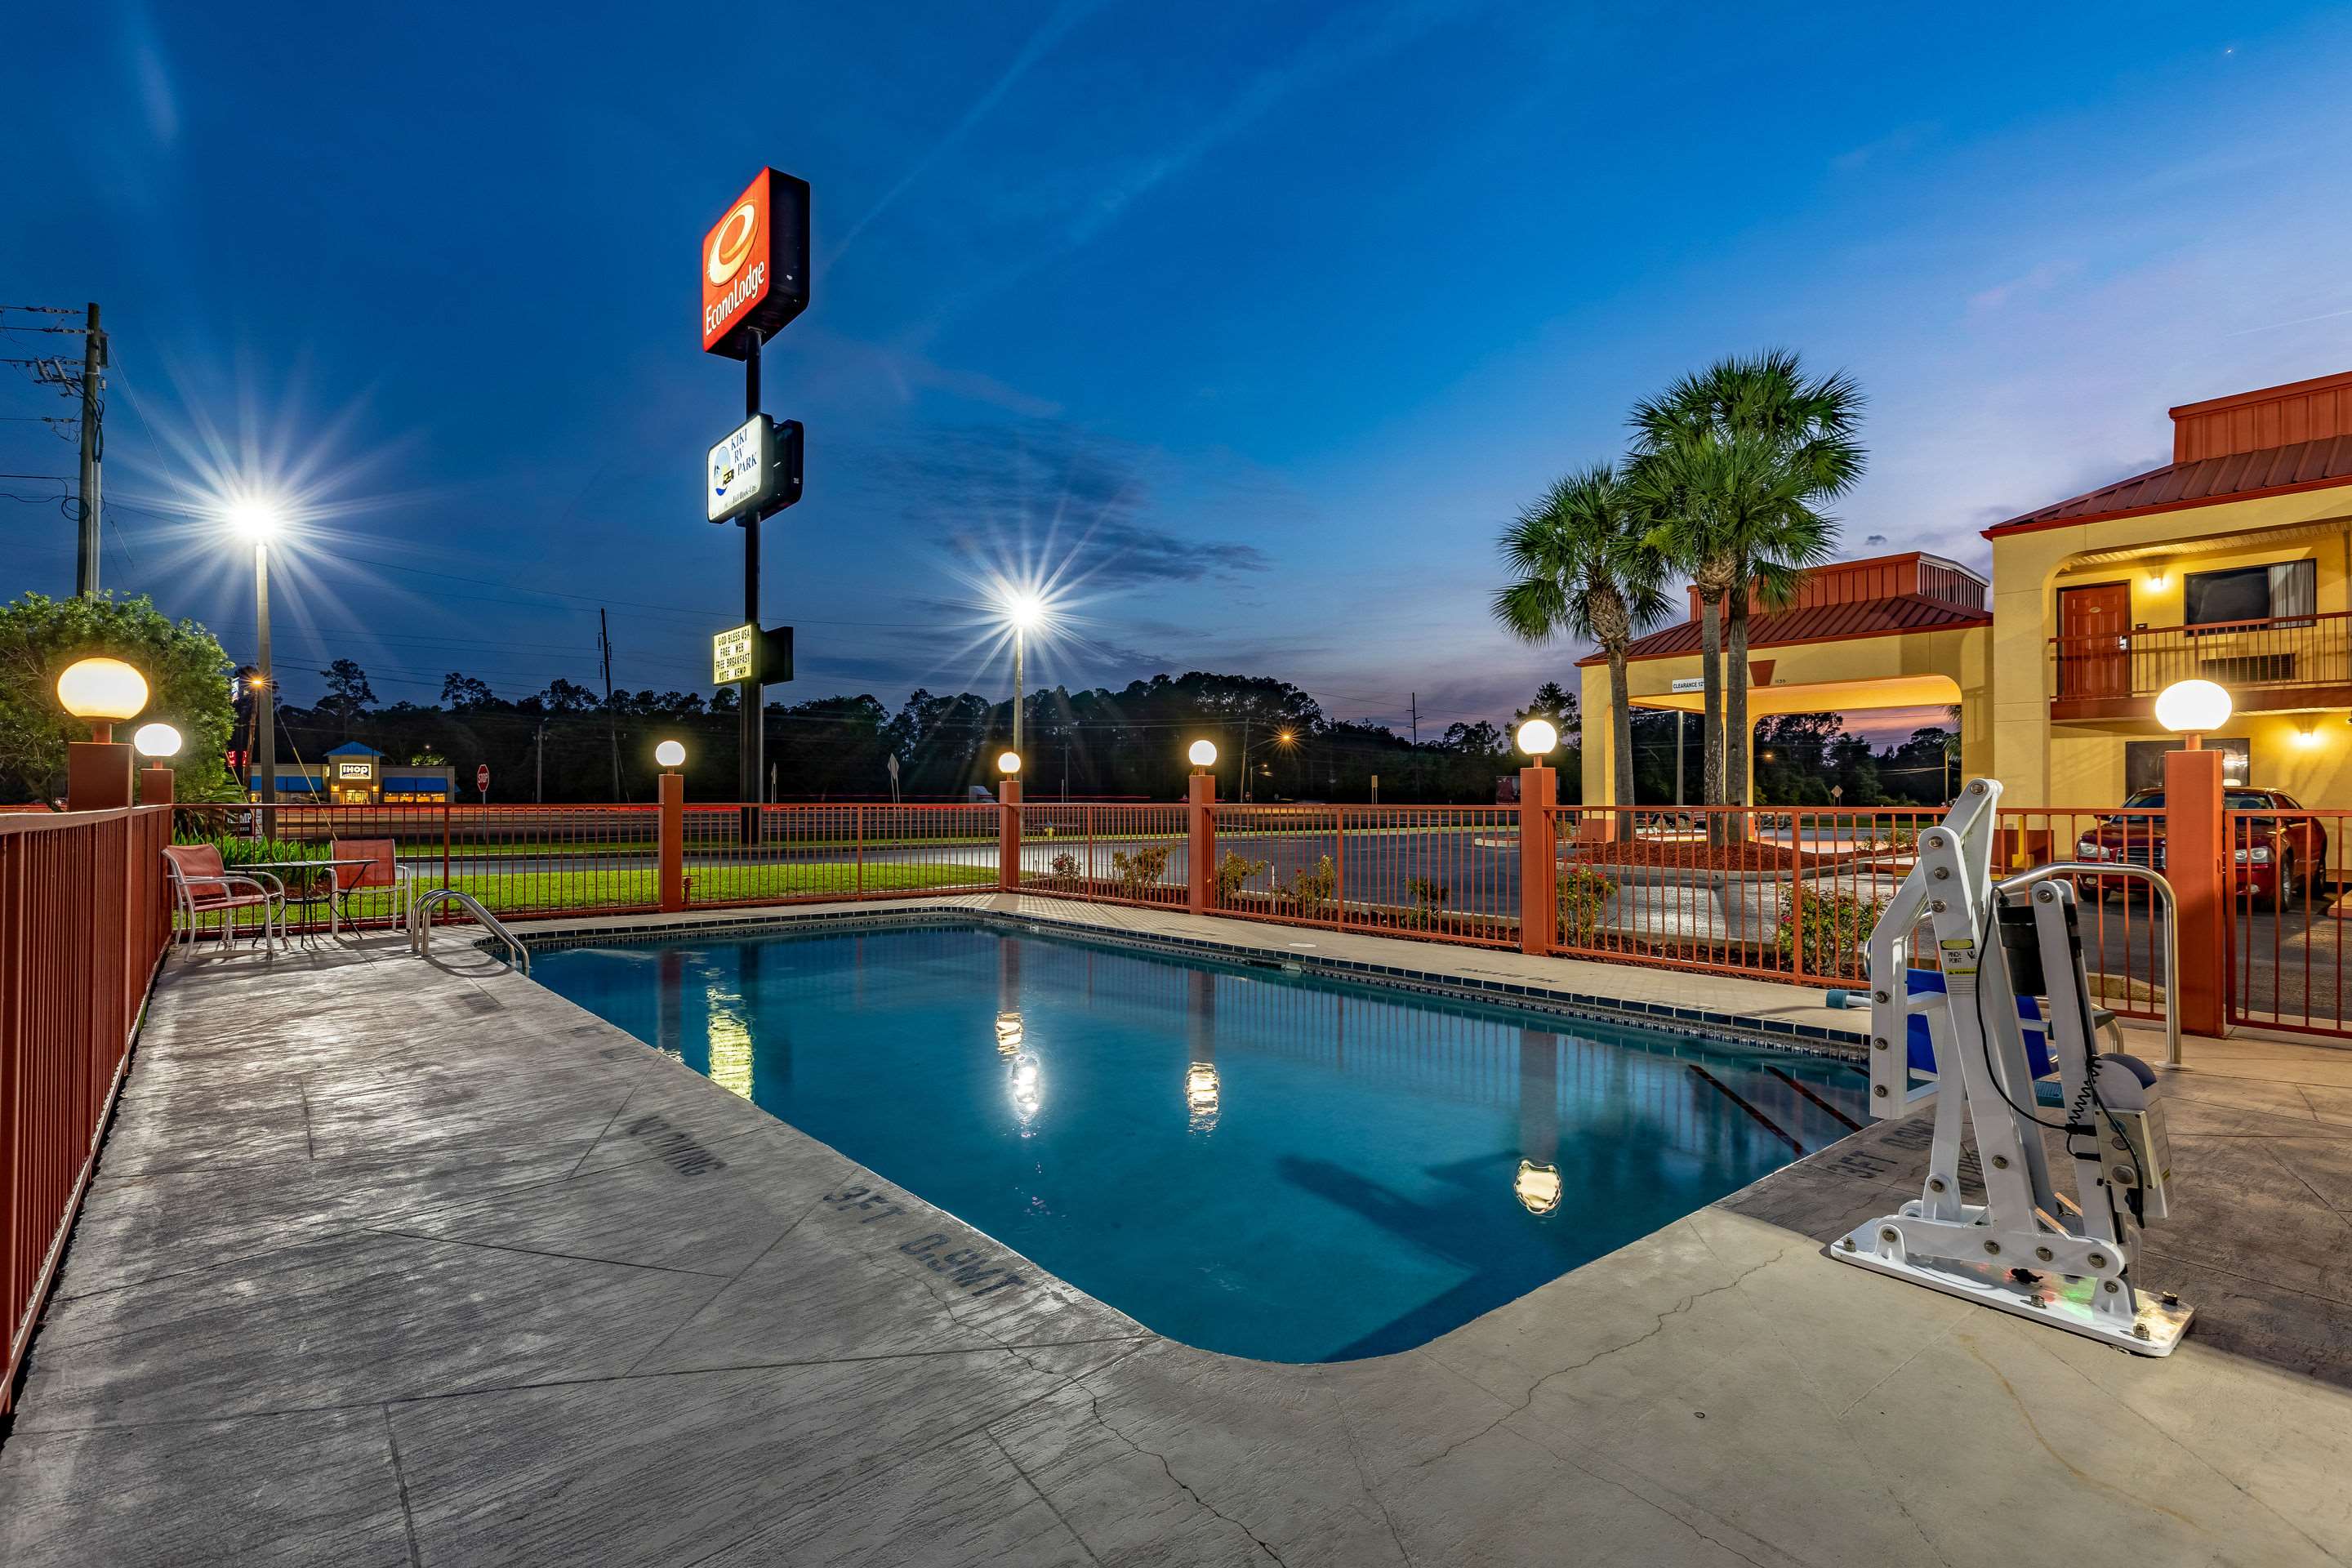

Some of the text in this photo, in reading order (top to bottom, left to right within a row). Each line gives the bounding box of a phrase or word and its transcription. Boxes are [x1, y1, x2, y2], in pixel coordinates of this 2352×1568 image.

[706, 261, 765, 336] EconoLodge
[731, 428, 747, 451] KIKI
[735, 445, 744, 463] RV
[737, 452, 757, 476] PARK
[718, 627, 750, 646] GOD BLESS USA
[719, 643, 744, 657] FREE WEB
[715, 653, 750, 670] FREE BREAKFAST
[719, 666, 746, 681] VOTE KEMP
[342, 765, 368, 775] IHOP
[479, 773, 488, 783] STOP
